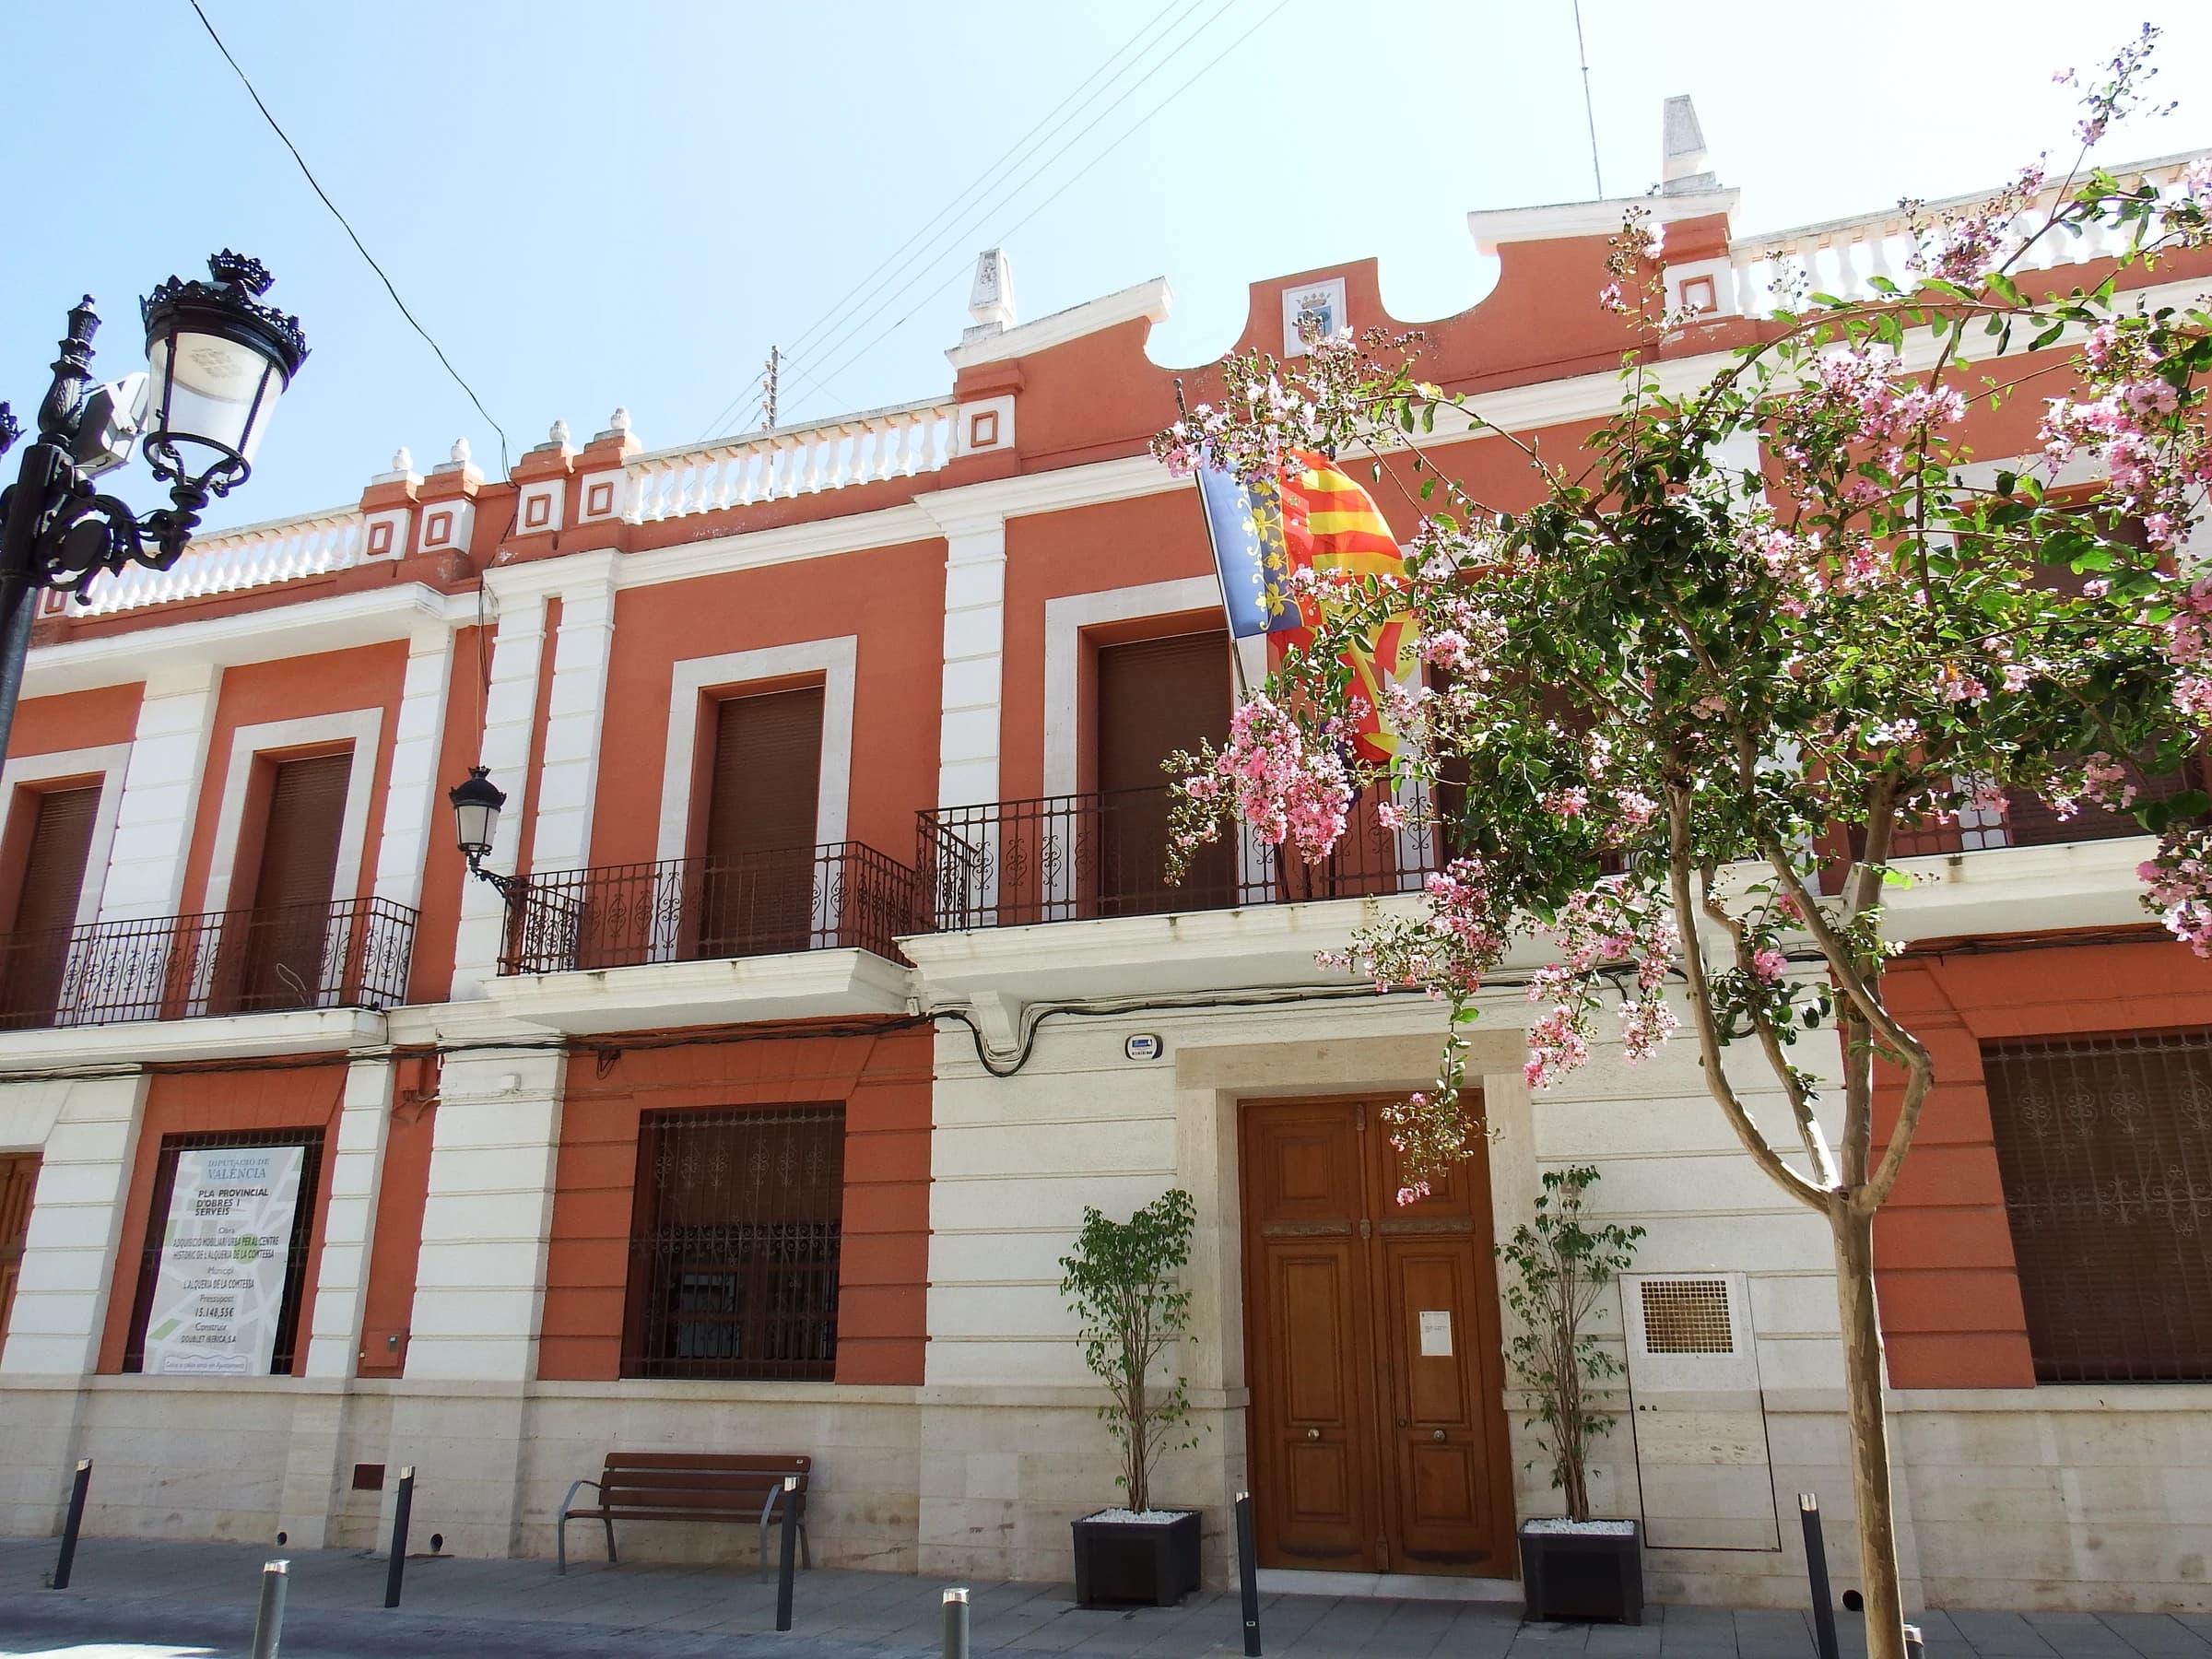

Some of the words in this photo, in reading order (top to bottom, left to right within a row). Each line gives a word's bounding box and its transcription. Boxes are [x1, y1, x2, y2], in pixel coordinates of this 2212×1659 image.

[257, 1158, 271, 1166] DE
[198, 1190, 215, 1198] PLA
[218, 1188, 268, 1197] PROVINCIAL
[196, 1199, 233, 1207] D'OBRES
[195, 1207, 229, 1216] SERVEIS
[259, 1236, 279, 1246] CENTRE
